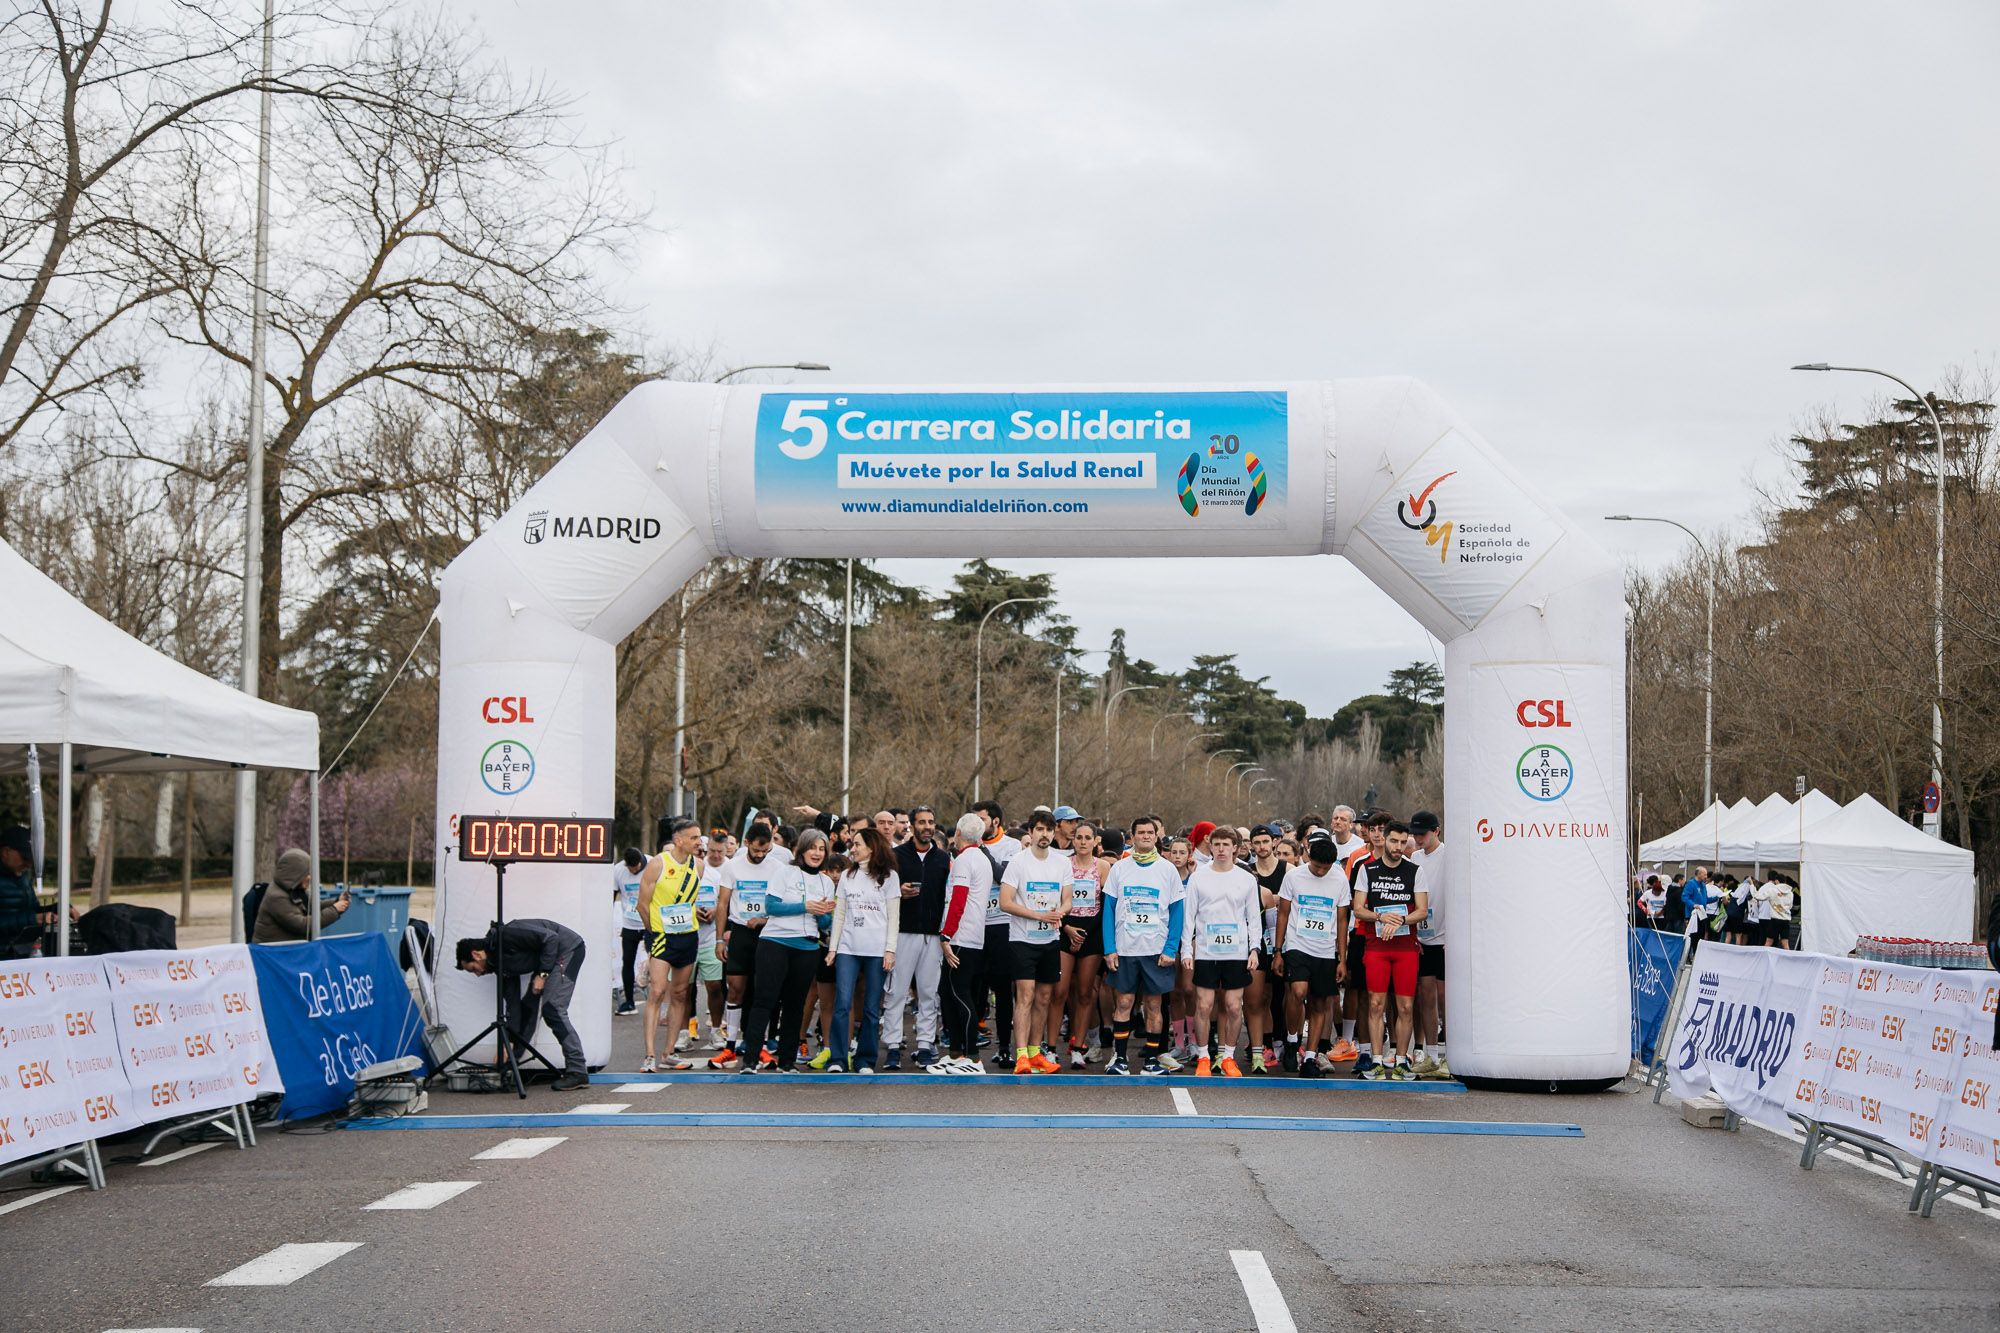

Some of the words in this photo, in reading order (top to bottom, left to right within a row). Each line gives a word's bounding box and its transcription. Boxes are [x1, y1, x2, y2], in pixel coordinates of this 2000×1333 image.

[836, 410, 995, 441] Carrera
[1008, 409, 1191, 441] Solidaria
[850, 461, 941, 478] Muévete
[948, 467, 984, 482] por
[990, 461, 1010, 478] la
[1016, 461, 1077, 478] Salud
[1084, 460, 1143, 478] Renal
[1201, 465, 1217, 474] Día
[1201, 477, 1241, 486] Mundial
[1201, 488, 1216, 497] del
[1218, 488, 1246, 497] Riñón
[842, 499, 1089, 514] www.diamundialdelriñon.com
[553, 516, 662, 544] MADRID
[1459, 523, 1512, 534] Sociedad
[1459, 537, 1513, 551] Española
[1516, 537, 1531, 548] de
[482, 696, 535, 724] CSL
[1516, 699, 1571, 728] CSL
[485, 763, 530, 773] BAYER
[502, 745, 512, 791] BAYER
[1521, 768, 1569, 778] BAYER
[1540, 749, 1551, 797] BAYER
[470, 821, 605, 858] 00:00:00
[1503, 823, 1609, 838] DIAVERUM
[1371, 881, 1405, 890] MADRID
[1380, 892, 1411, 901] MADRID
[670, 915, 686, 925] 311
[746, 903, 761, 912] 80
[859, 904, 881, 912] RENAL
[1136, 914, 1149, 924] 32
[1305, 919, 1325, 931] 378
[1215, 935, 1232, 945] 415
[167, 959, 198, 981] GSK
[1857, 967, 1882, 992] GSK
[0, 972, 36, 999] GSK
[299, 972, 333, 1018] De
[325, 968, 346, 1014] la
[340, 965, 374, 1010] Base
[133, 1002, 162, 1027] GSK
[223, 992, 252, 1014] GSK
[65, 1011, 97, 1037] GSK
[1820, 1004, 1838, 1028] GSK
[1881, 1014, 1906, 1042] GSK
[1931, 1025, 1957, 1054] GSK
[185, 1033, 216, 1058] GSK
[1705, 1001, 1795, 1090] MADRID
[18, 1059, 55, 1089] GSK
[320, 1037, 339, 1086] al
[1835, 1046, 1861, 1072] GSK
[1961, 1078, 1991, 1109] GSK
[151, 1080, 181, 1107] GSK
[85, 1094, 119, 1122] GSK
[1796, 1079, 1818, 1103] GSK
[1861, 1096, 1882, 1125] GSK
[1909, 1111, 1934, 1142] GSK
